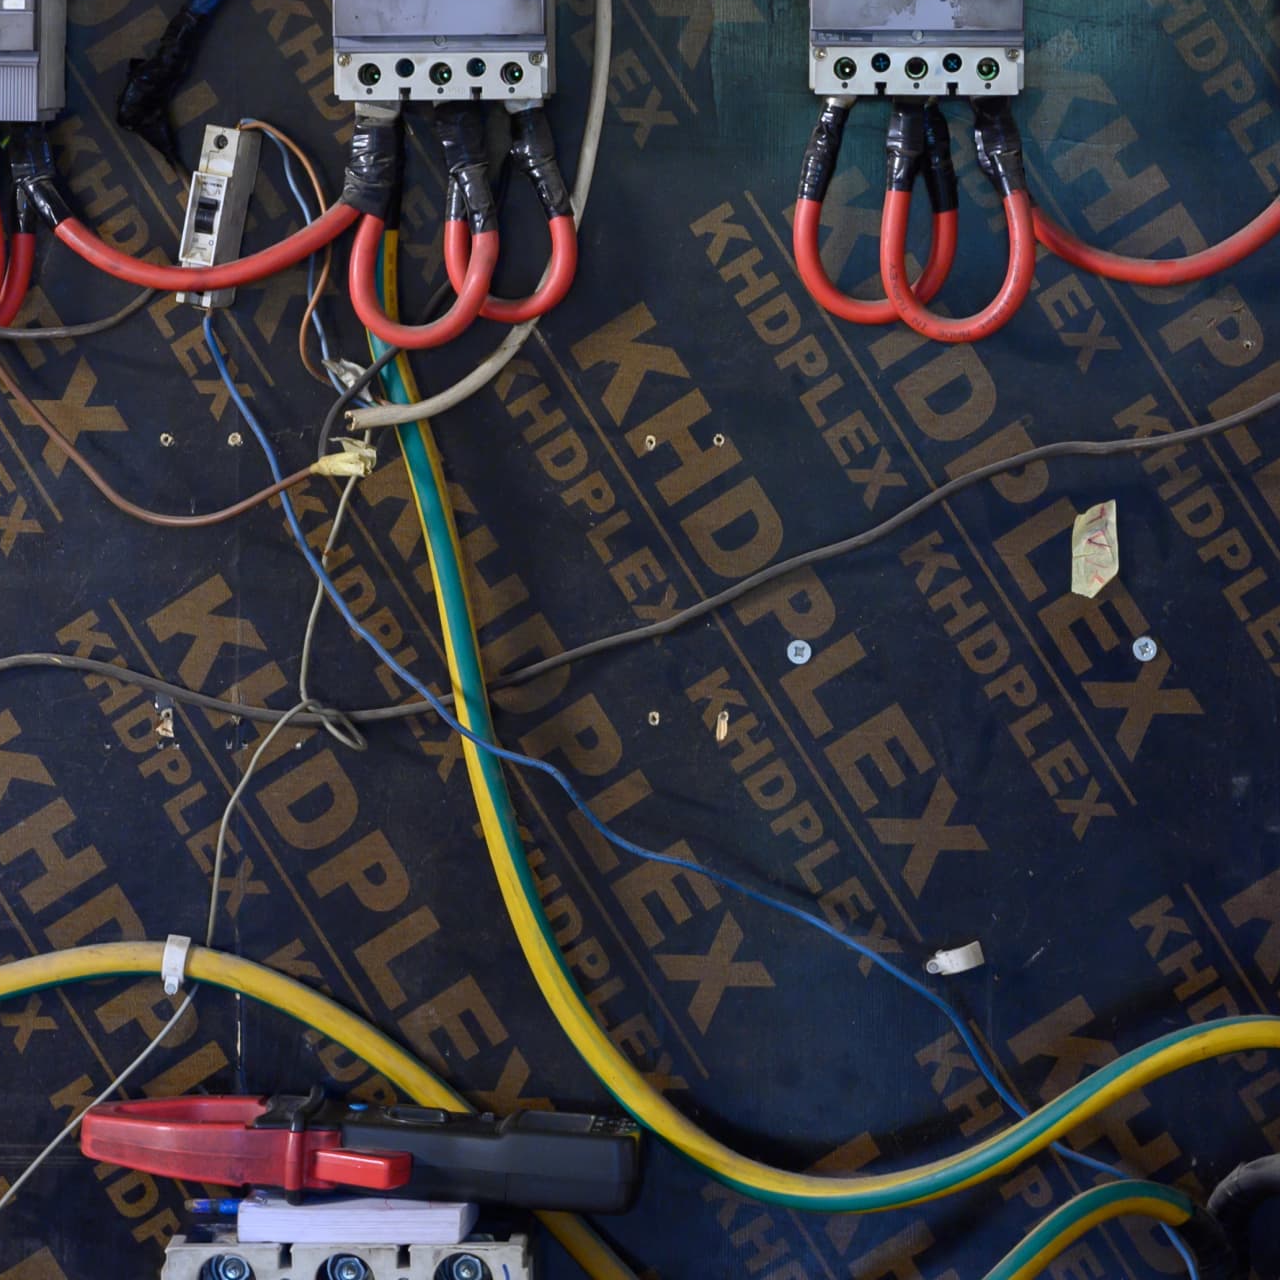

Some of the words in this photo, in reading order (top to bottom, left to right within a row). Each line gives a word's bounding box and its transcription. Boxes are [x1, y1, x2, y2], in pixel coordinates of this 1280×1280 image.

[686, 199, 911, 516] KHDPLEX
[564, 296, 991, 902] KHDPLEX
[895, 528, 1119, 845] KHDPLEX
[52, 609, 271, 920] KHDPLEX
[682, 664, 904, 978] KHDPLEX
